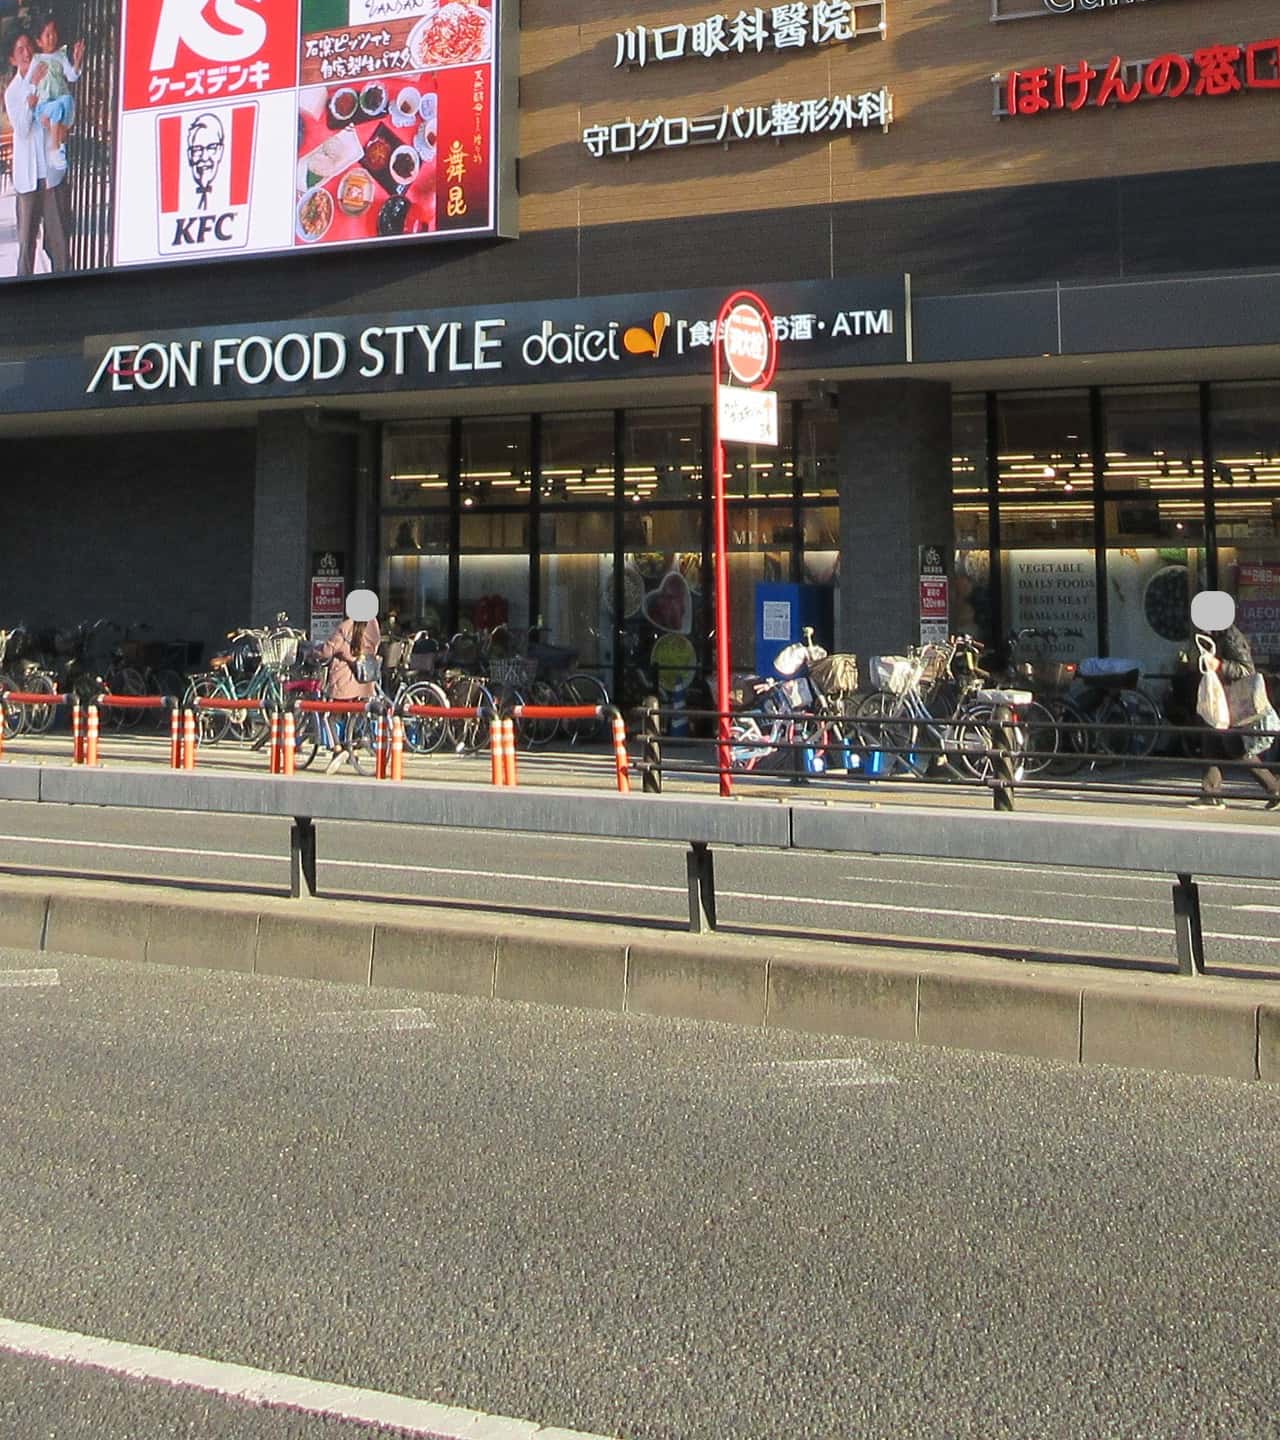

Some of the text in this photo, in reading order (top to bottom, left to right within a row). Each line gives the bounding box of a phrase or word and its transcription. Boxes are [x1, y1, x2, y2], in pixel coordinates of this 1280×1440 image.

[149, 61, 270, 102] ケーズデンキ
[583, 89, 888, 157] 守口グローバル整形外科
[171, 212, 235, 247] KFC
[213, 332, 347, 385] FOOD
[359, 319, 506, 377] STYLE
[1018, 563, 1084, 573] VEGETABLE
